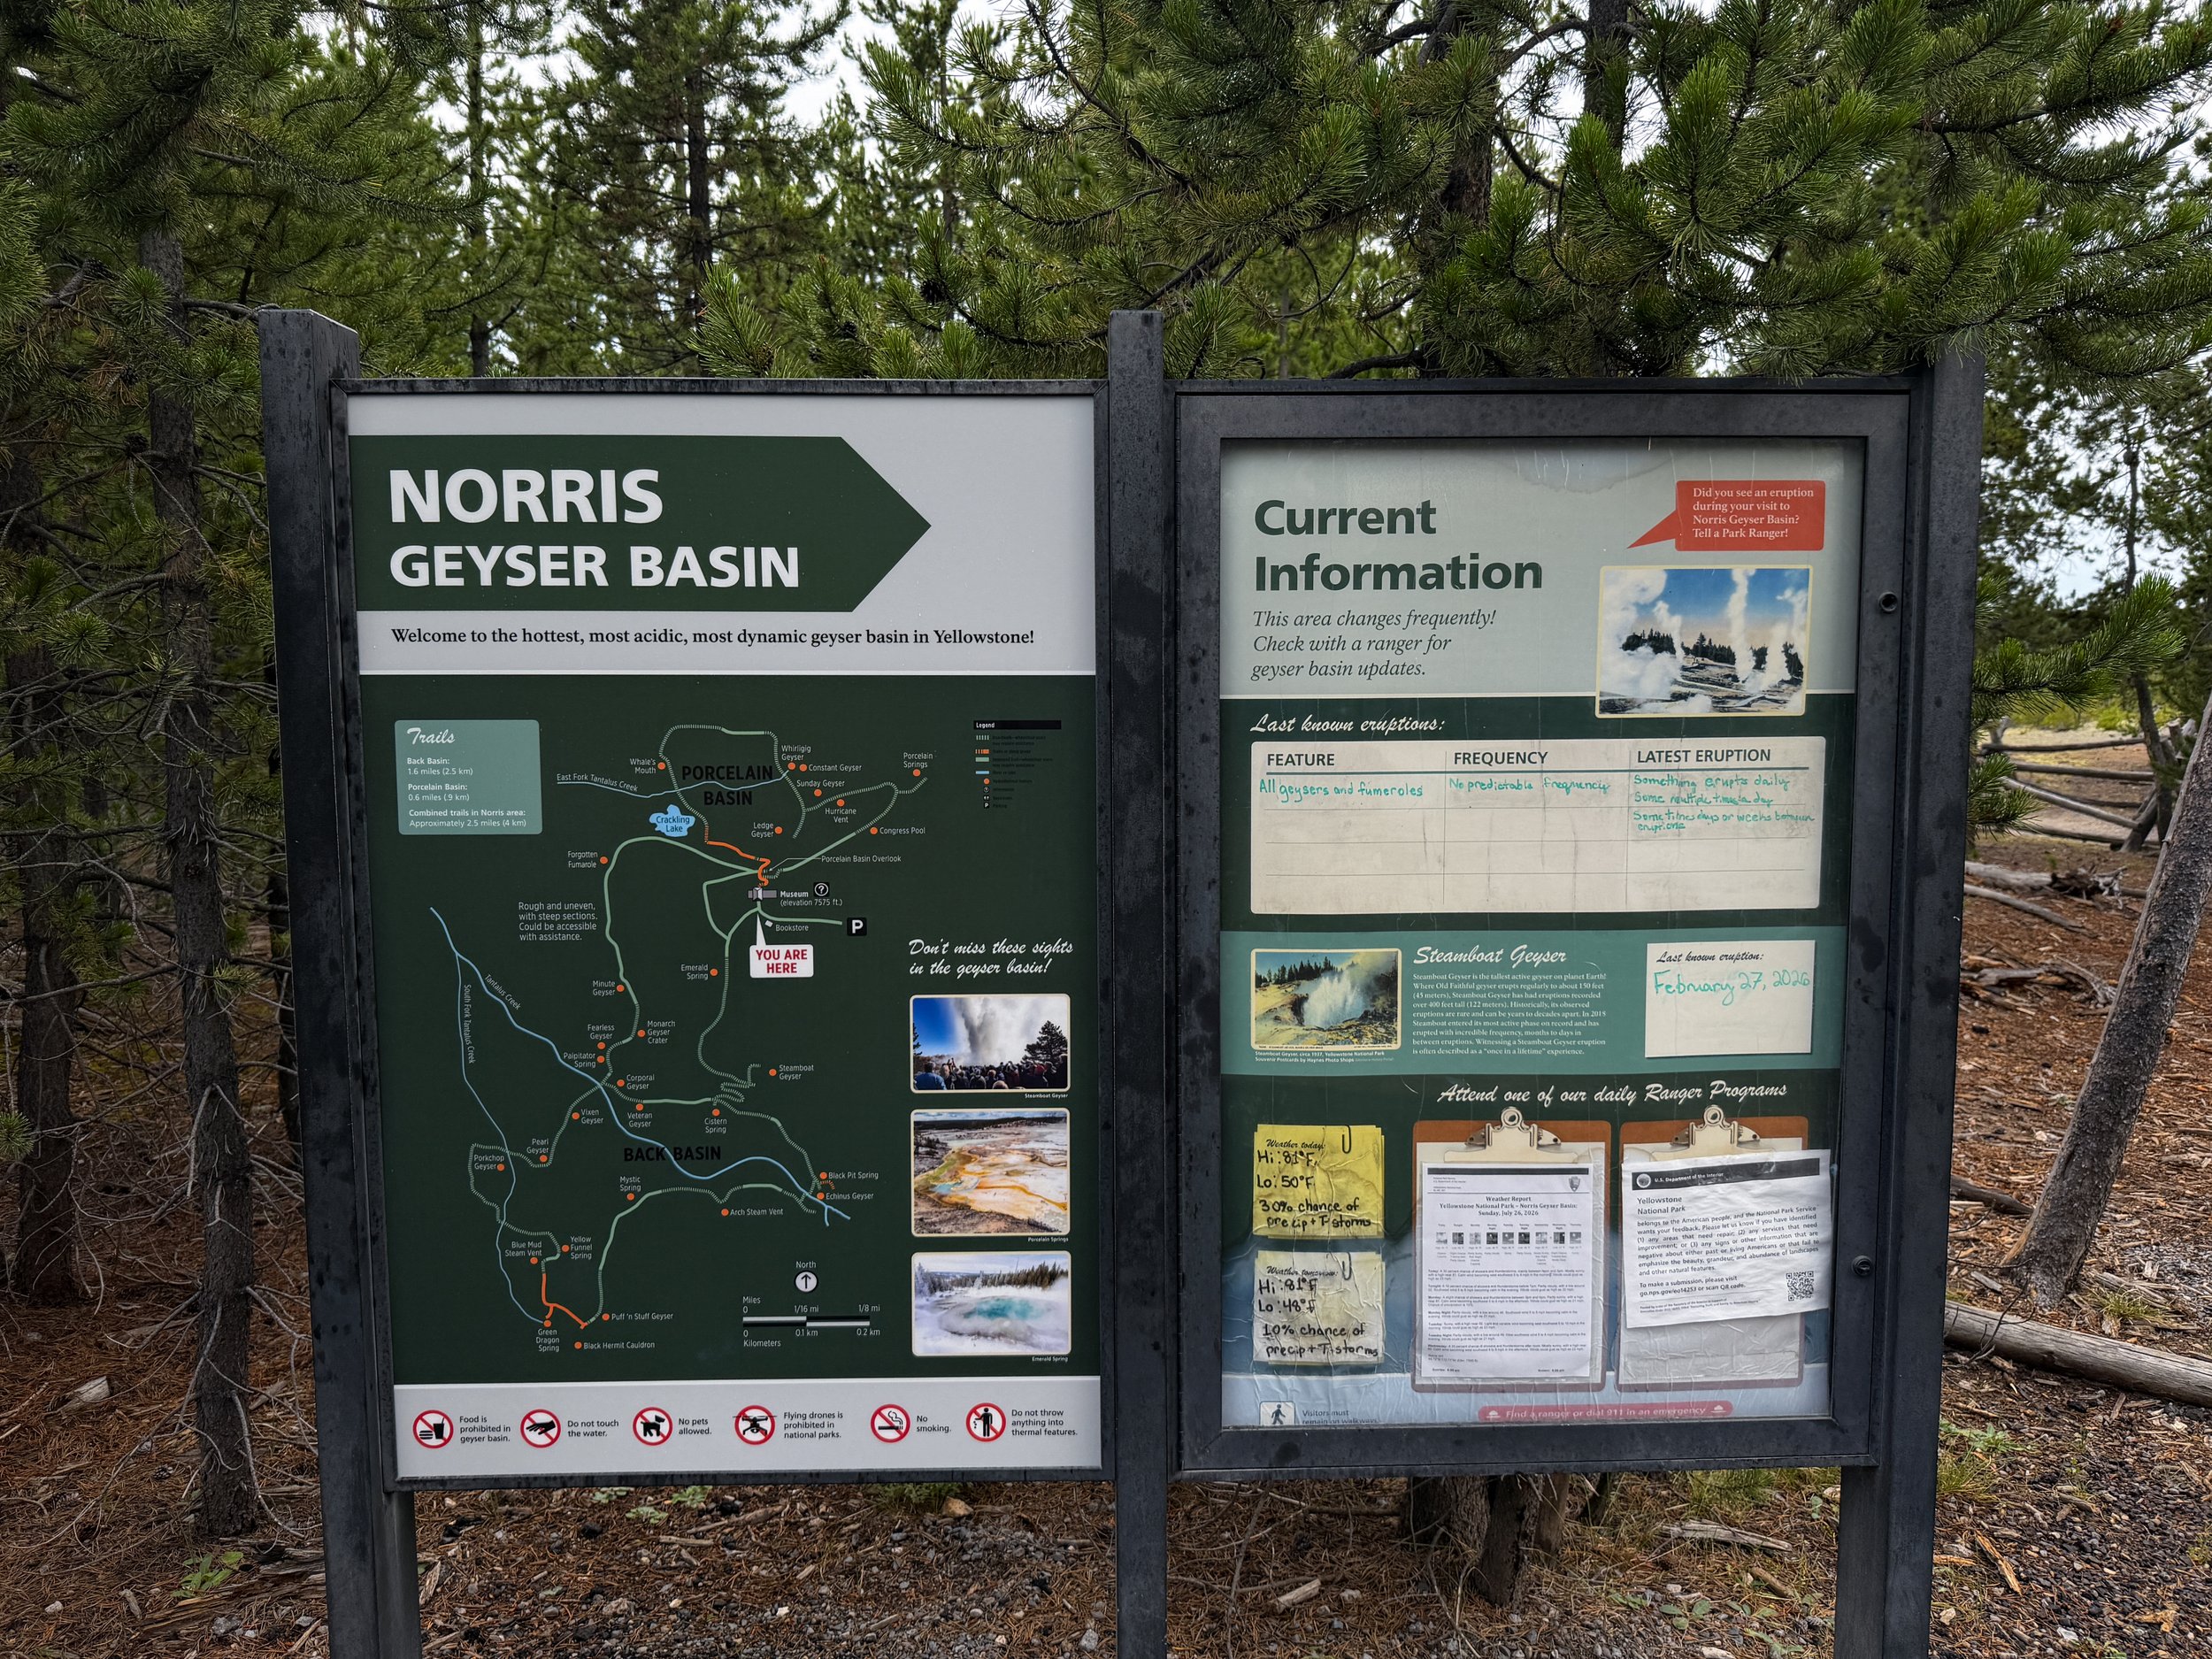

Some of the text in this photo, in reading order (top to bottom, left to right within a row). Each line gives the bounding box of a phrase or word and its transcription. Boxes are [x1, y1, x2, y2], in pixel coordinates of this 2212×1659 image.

[390, 469, 662, 523] NORRIS
[1693, 487, 1712, 497] Did
[1714, 490, 1734, 500] you
[1769, 487, 1814, 500] eruption
[1693, 501, 1790, 514] during your visit to
[1255, 500, 1436, 536] Current
[1693, 514, 1800, 527] Norris Geyser Basin?
[1692, 528, 1711, 538] Tell
[1722, 528, 1746, 538] Park
[1749, 528, 1788, 540] Ranger!
[390, 545, 798, 588] GEYSER BASIN
[1256, 552, 1542, 591] Information
[1253, 609, 1496, 630] This area changes frequently!
[391, 628, 1034, 647] Welcome to the hottest, most acidic, most dynamic geyser basin in Yellowstone!
[1254, 634, 1452, 655] Check with a ranger for
[1251, 660, 1425, 681] geyser basin updates.
[1250, 714, 1445, 736] Last known eruptions:
[407, 727, 455, 744] Trails
[781, 744, 811, 754] Whirligig
[427, 757, 450, 765] Basin:
[781, 753, 804, 762] Geyser
[1267, 753, 1335, 766] FEATURE
[1454, 752, 1548, 767] FREQUENCY
[1637, 749, 1771, 763] LATEST ERUPTION
[442, 767, 457, 776] (2.5
[458, 768, 473, 776] km)
[682, 765, 773, 780] PORCELAIN
[839, 764, 862, 772] Geyser
[1260, 778, 1275, 793] All
[1279, 785, 1329, 803] geysers
[1333, 782, 1354, 795] and
[1450, 778, 1464, 789] No
[1468, 778, 1533, 792] predictable
[704, 790, 752, 805] BASIN
[879, 827, 910, 836] Congress
[755, 949, 808, 961] YOU ARE
[909, 938, 1073, 959] Don't miss these sights
[1413, 944, 1566, 969] Steamboat Geyser
[1656, 951, 1764, 964] Last known eruption:
[767, 962, 797, 974] HERE
[909, 958, 1052, 979] in the geyser basin!
[1654, 969, 1811, 1006] February 27, 2026
[779, 1072, 802, 1081] Geyser
[1437, 1080, 1787, 1107] Attend one of our daily Ranger Programs
[1266, 1139, 1298, 1148] Weather
[624, 1146, 721, 1161] BACK BASIN
[858, 1171, 879, 1180] Spring
[826, 1192, 874, 1201] Echinus Geyser
[1259, 1197, 1359, 1214] 30% chance of
[1637, 1206, 1669, 1215] National
[459, 1415, 479, 1423] Food
[692, 1418, 708, 1427] pets
[1011, 1419, 1046, 1428] anything
[460, 1425, 501, 1434] prohibited
[678, 1427, 711, 1435] allowed.
[916, 1424, 951, 1433] smoking.
[1044, 1428, 1078, 1436] features.
